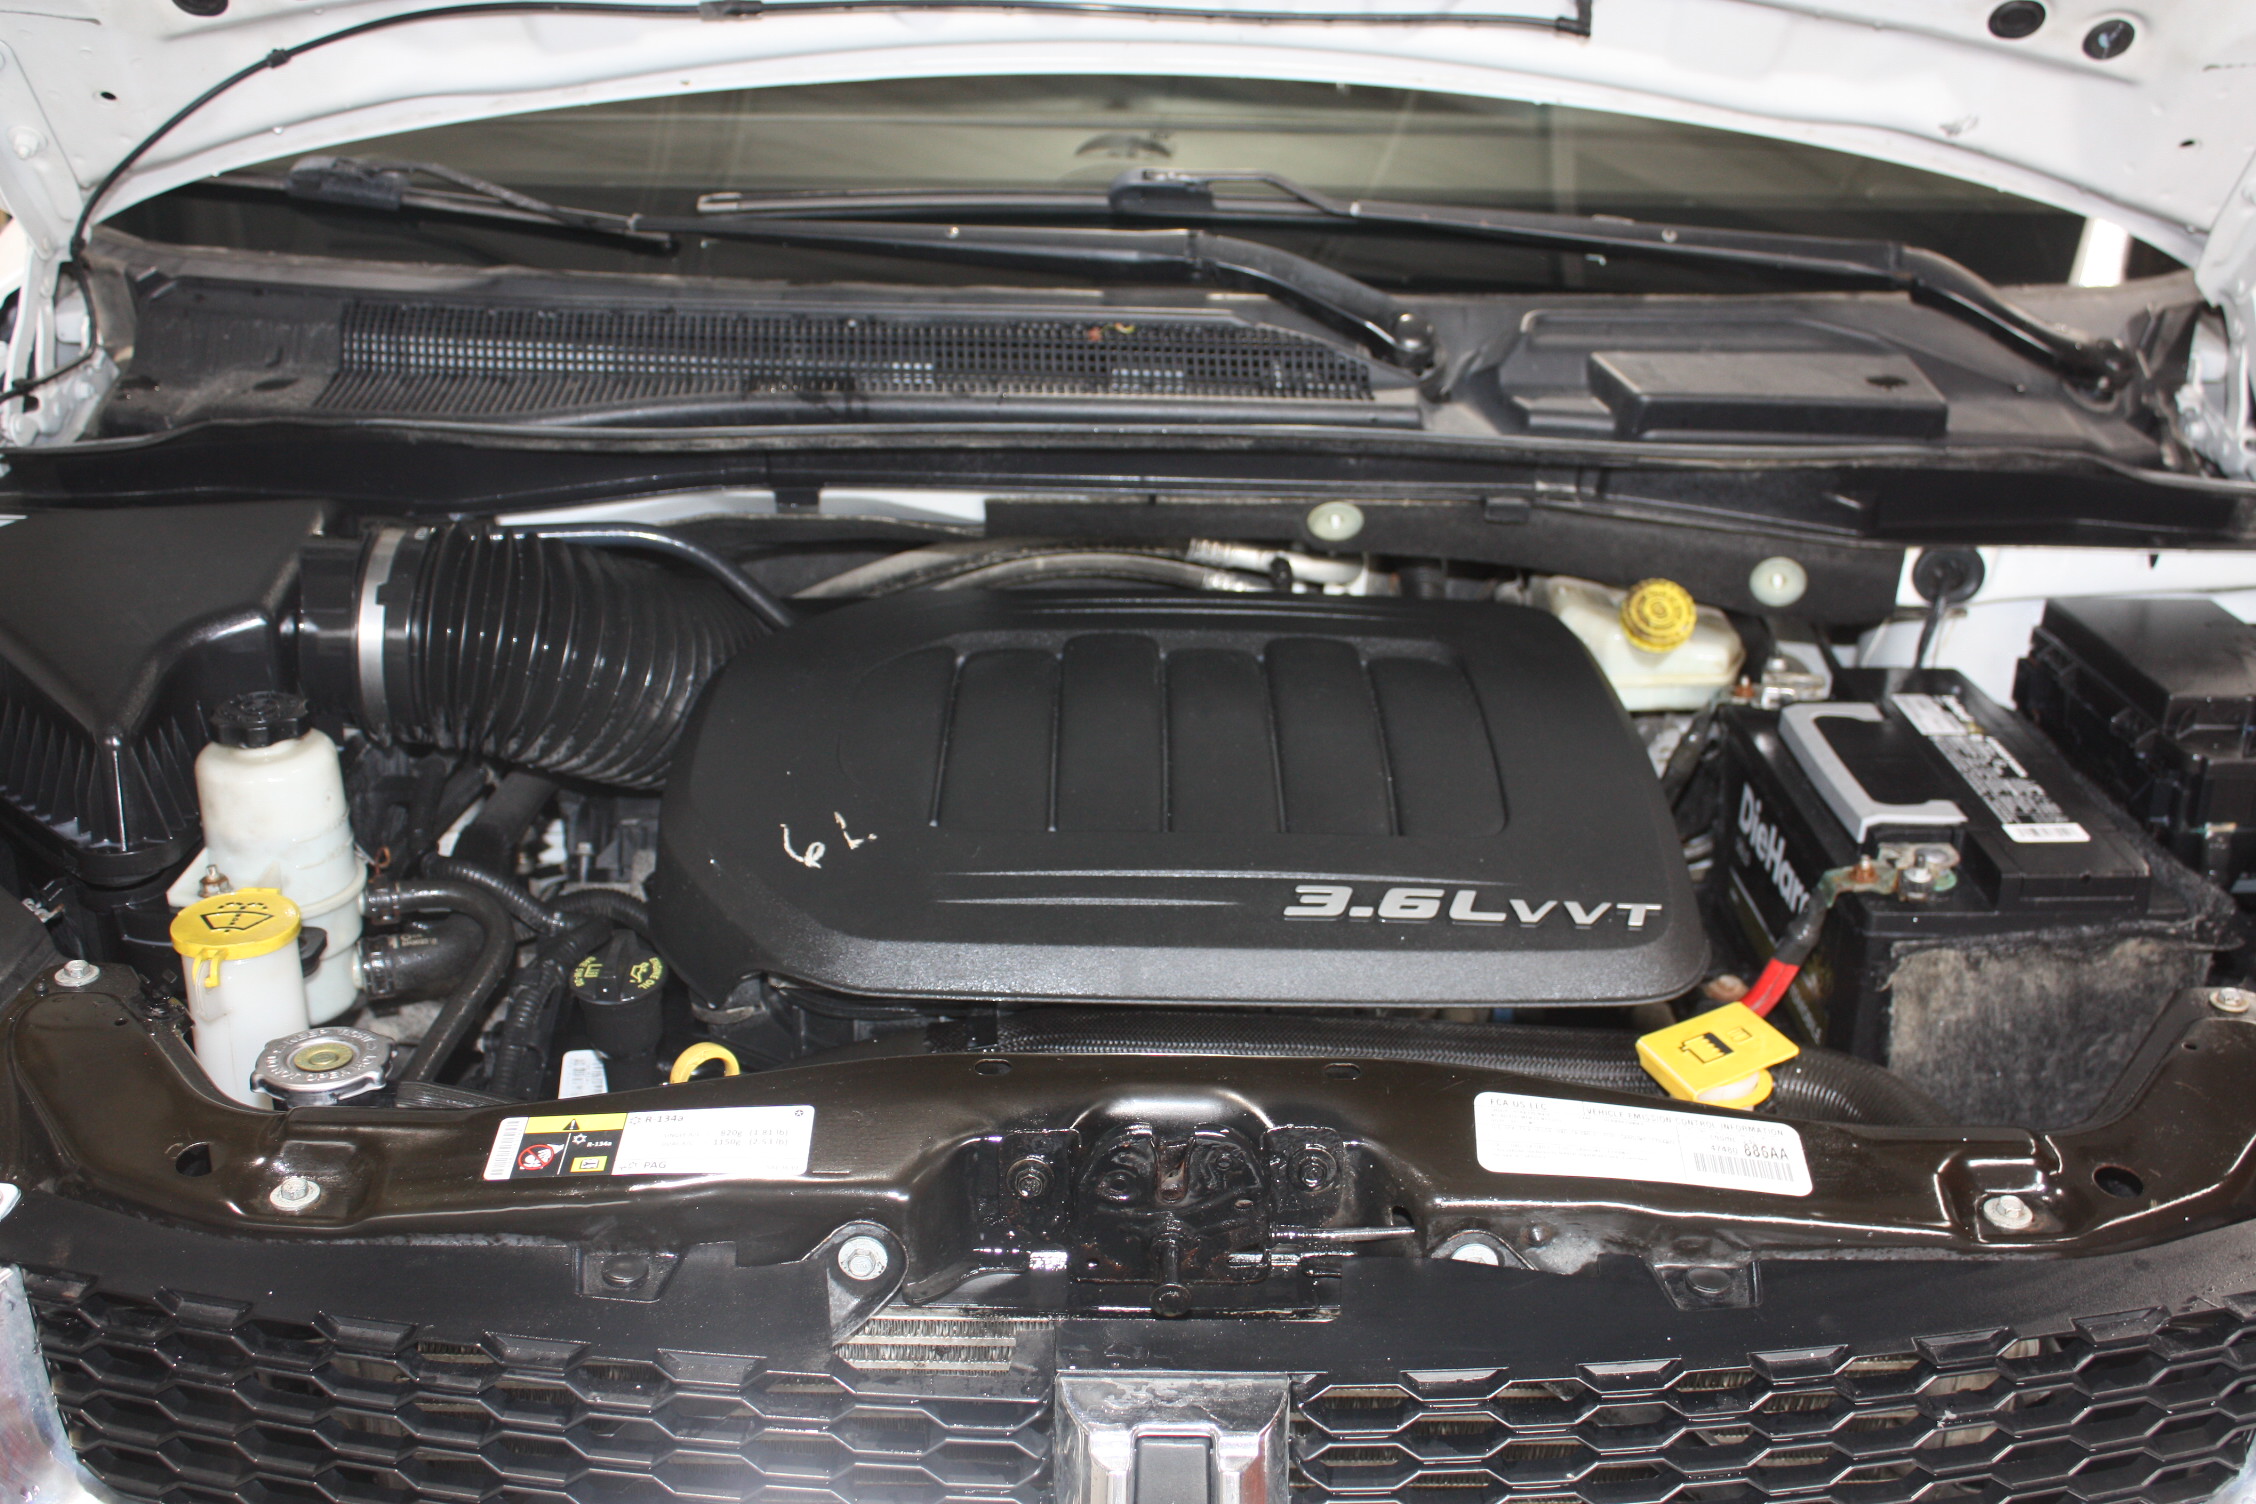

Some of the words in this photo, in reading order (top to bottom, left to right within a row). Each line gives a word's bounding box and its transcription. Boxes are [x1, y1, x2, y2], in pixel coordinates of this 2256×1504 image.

[637, 979, 656, 990] OIL
[1490, 1098, 1509, 1106] FCA
[1512, 1100, 1526, 1108] US
[645, 1114, 684, 1123] R-134a
[1586, 1106, 1623, 1118] VEHICLE
[1628, 1112, 1672, 1124] EMISSION
[1675, 1117, 1715, 1129] CONTROL
[1720, 1122, 1784, 1136] INFORMATION
[1743, 1143, 1789, 1160] 886AA
[643, 1161, 667, 1169] PAG
